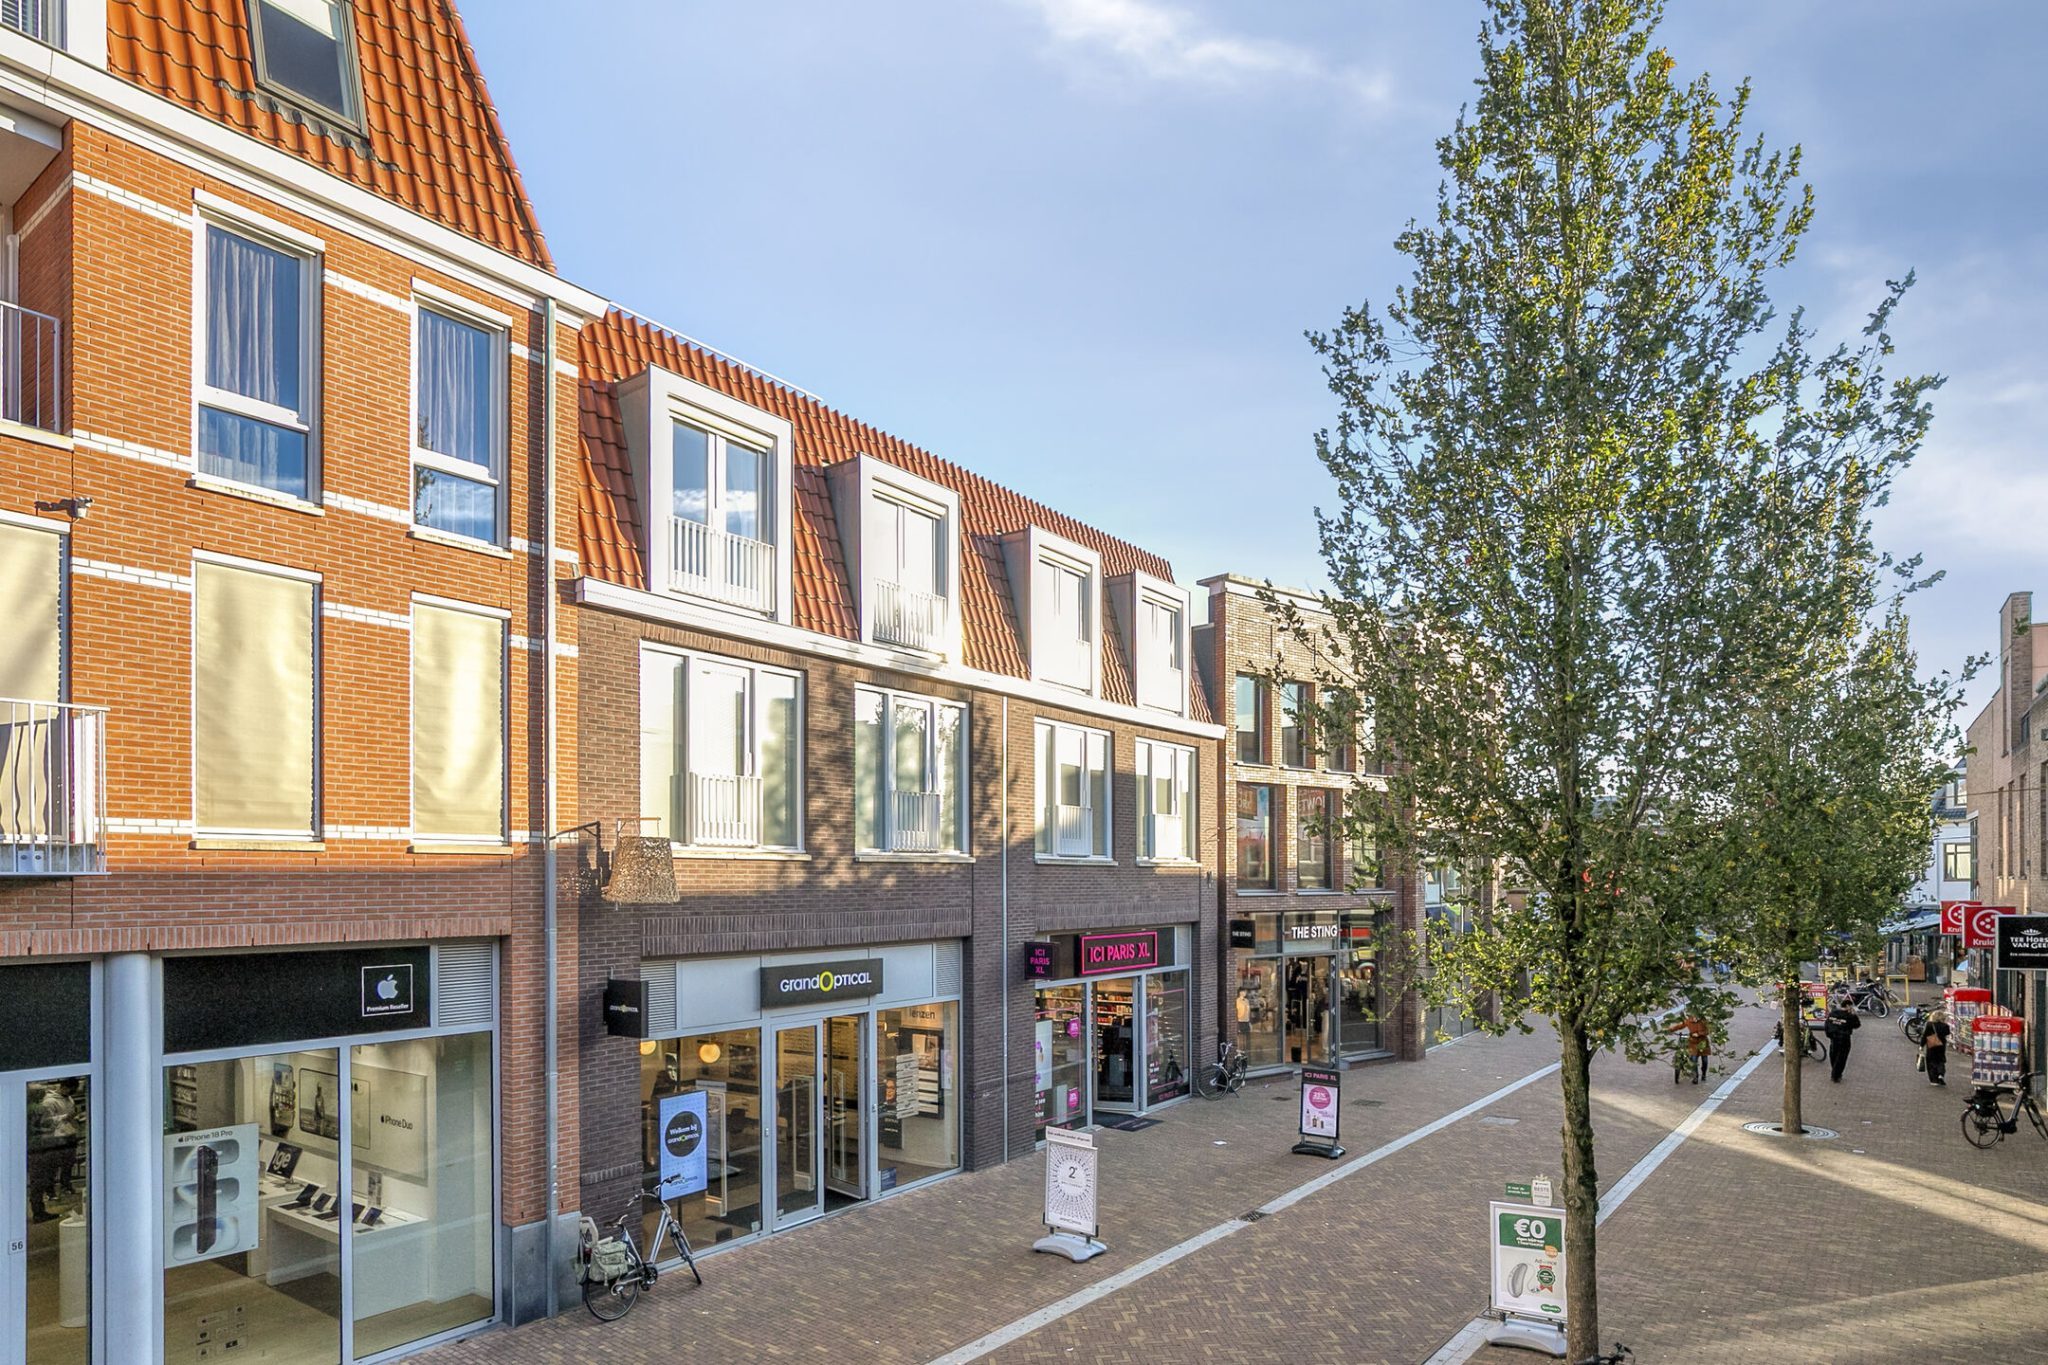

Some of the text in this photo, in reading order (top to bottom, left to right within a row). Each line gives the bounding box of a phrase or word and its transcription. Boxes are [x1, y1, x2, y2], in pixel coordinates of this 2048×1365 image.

[1291, 924, 1338, 939] THE STING
[1089, 942, 1150, 963] ICI PARIS XL
[1030, 957, 1050, 965] PARIS
[1035, 966, 1045, 974] XL
[1313, 1072, 1328, 1080] PARIS
[185, 1133, 210, 1142] iPhone
[1513, 1218, 1546, 1239] €0
[11, 1241, 23, 1251] 56
